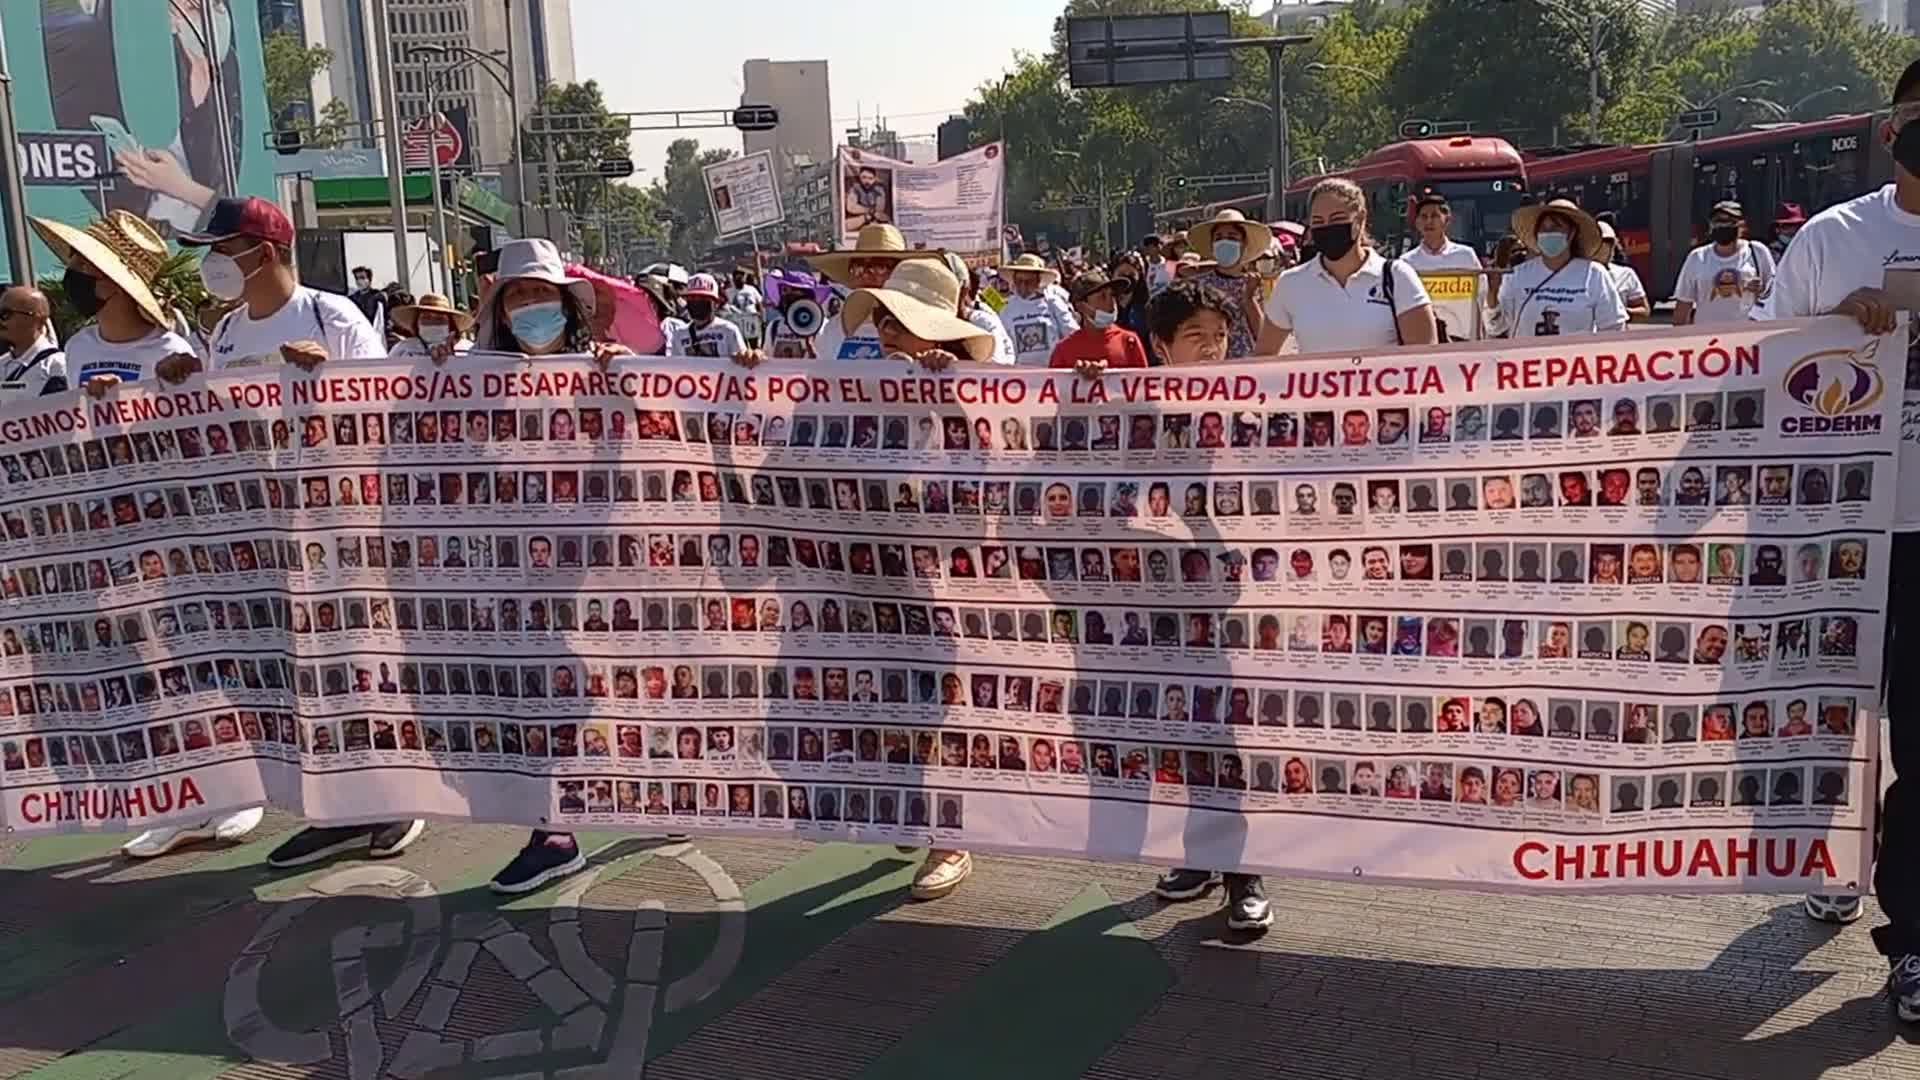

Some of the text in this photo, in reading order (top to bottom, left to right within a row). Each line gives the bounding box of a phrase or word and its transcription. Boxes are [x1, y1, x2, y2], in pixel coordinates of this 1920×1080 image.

[0, 338, 1761, 444] GIMOS MEMORIA POR NUESTROS/AS DESAPARECIDOS/AS POR EL DERECHO A LA VERDAD, JUSTICIA Y REPARACIÓN
[1780, 414, 1882, 432] CEDEHM
[20, 777, 205, 824] CHIHUAHUA
[1512, 837, 1838, 881] CHIHUAHUA
